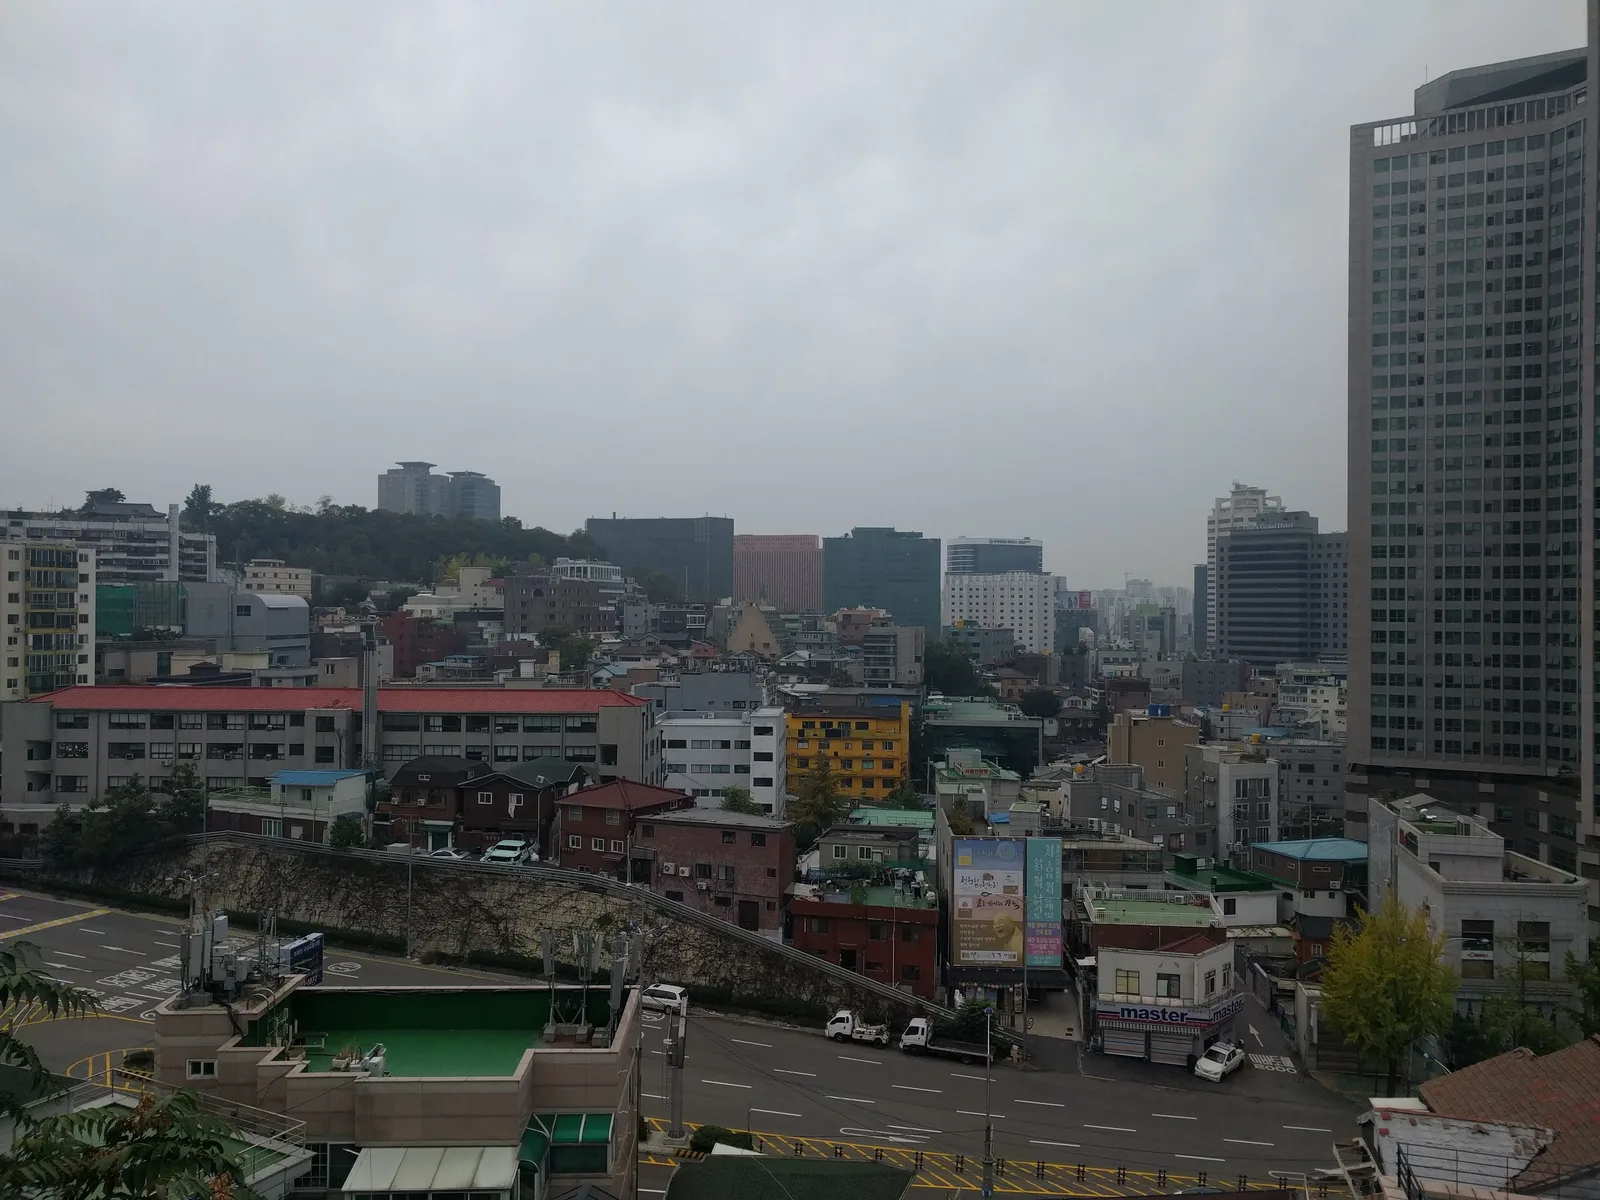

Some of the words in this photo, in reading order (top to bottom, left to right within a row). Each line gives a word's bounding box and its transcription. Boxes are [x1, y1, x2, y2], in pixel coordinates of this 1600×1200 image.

[1045, 860, 1053, 880] 108
[1120, 1007, 1188, 1023] master
[1213, 999, 1243, 1022] master
